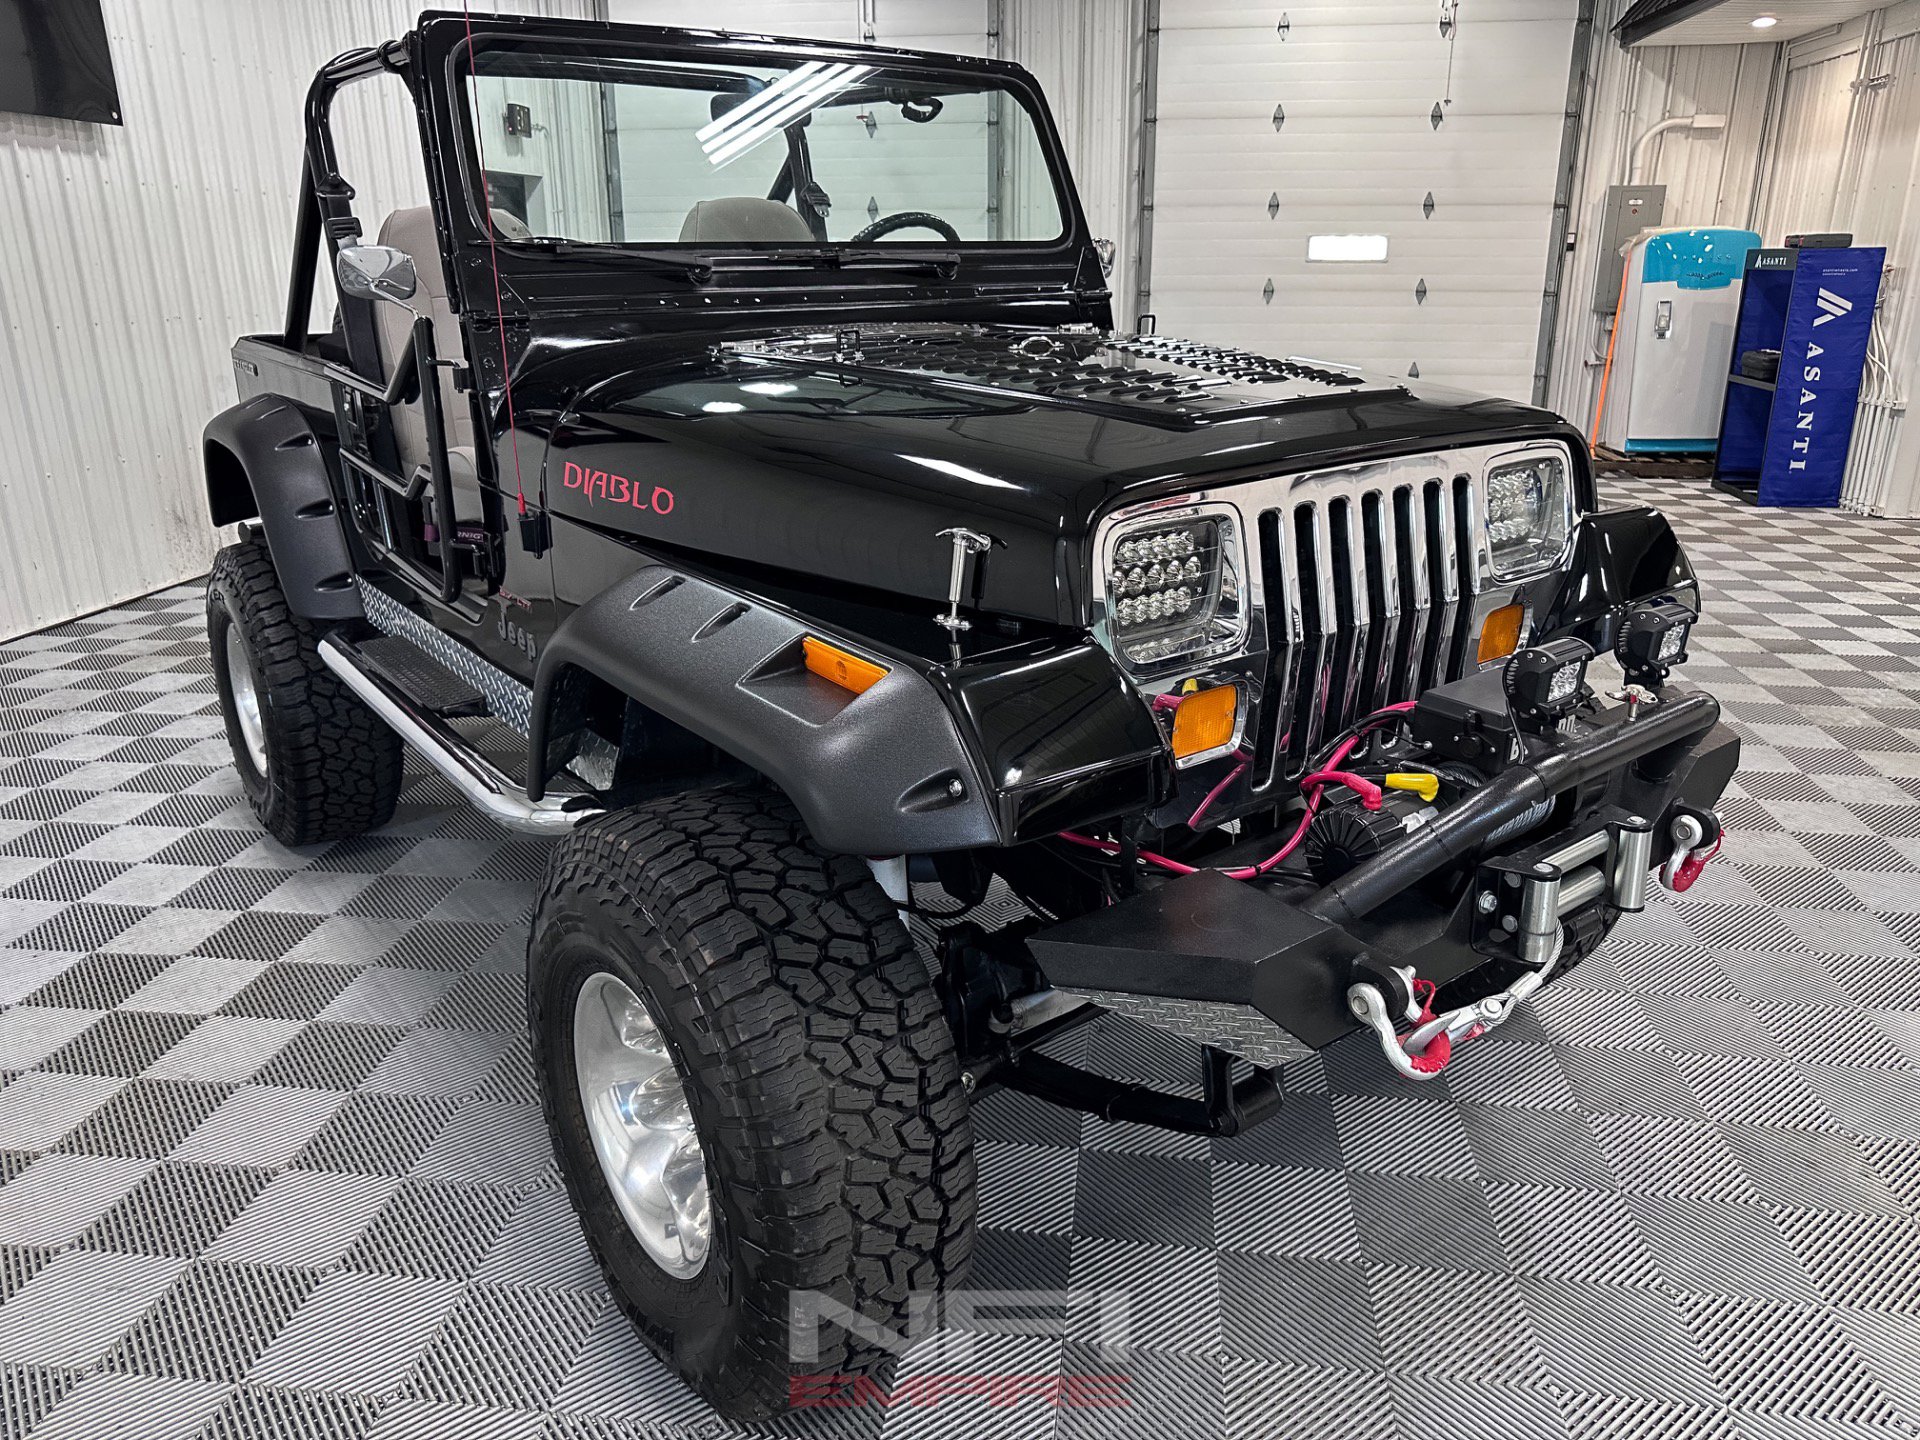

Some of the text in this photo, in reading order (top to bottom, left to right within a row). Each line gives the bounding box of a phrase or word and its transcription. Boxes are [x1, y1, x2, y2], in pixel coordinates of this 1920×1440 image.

[1762, 257, 1787, 266] ASANTI
[1790, 341, 1825, 471] ASANTI
[563, 461, 675, 515] DIABLO
[497, 611, 537, 662] Jeep
